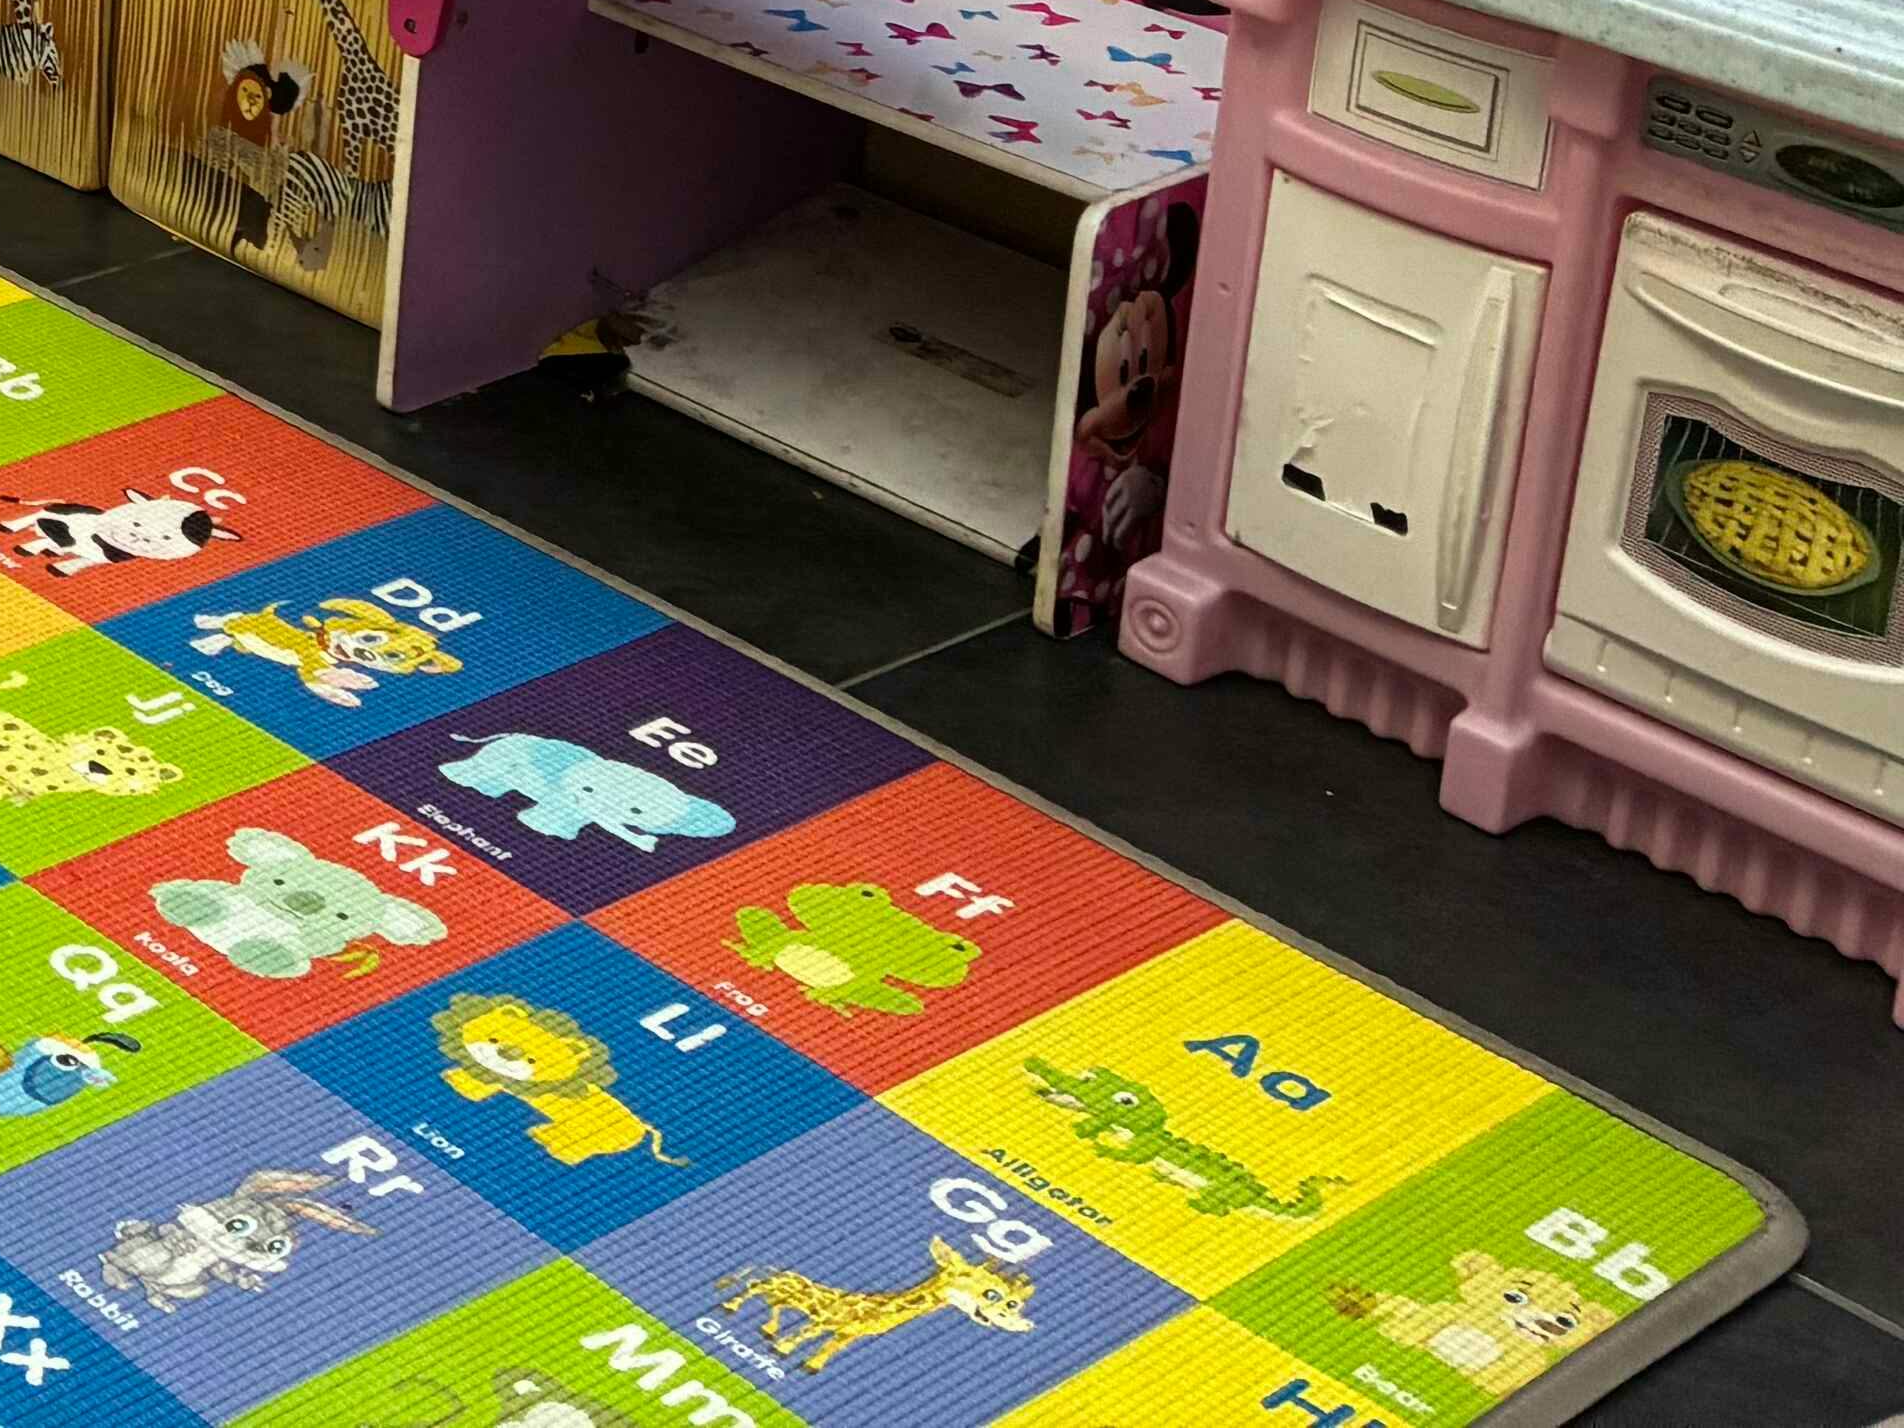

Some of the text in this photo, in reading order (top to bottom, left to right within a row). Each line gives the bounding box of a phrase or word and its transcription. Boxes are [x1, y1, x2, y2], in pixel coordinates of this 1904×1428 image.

[168, 466, 248, 511] Cc
[370, 576, 483, 633] Dd
[126, 690, 198, 727] Jj
[191, 669, 233, 696] Dog
[628, 716, 719, 770] Ee
[352, 820, 459, 888] Kk
[417, 801, 513, 864] Elephant
[913, 871, 1017, 921] Ff
[48, 943, 164, 1024] Qq
[713, 980, 768, 1018] Frog
[639, 1002, 728, 1053] Ll
[1183, 1033, 1332, 1112] Aa
[321, 1135, 424, 1197] Rr
[410, 1122, 464, 1160] Lion
[983, 1147, 1113, 1228] Alligator
[928, 1177, 1055, 1264] Gg
[1524, 1206, 1673, 1301] Bb
[57, 1268, 142, 1335] Rabbit
[695, 1316, 786, 1382] Giraffe
[1261, 1378, 1388, 1428] H
[1353, 1363, 1436, 1416] Bear
